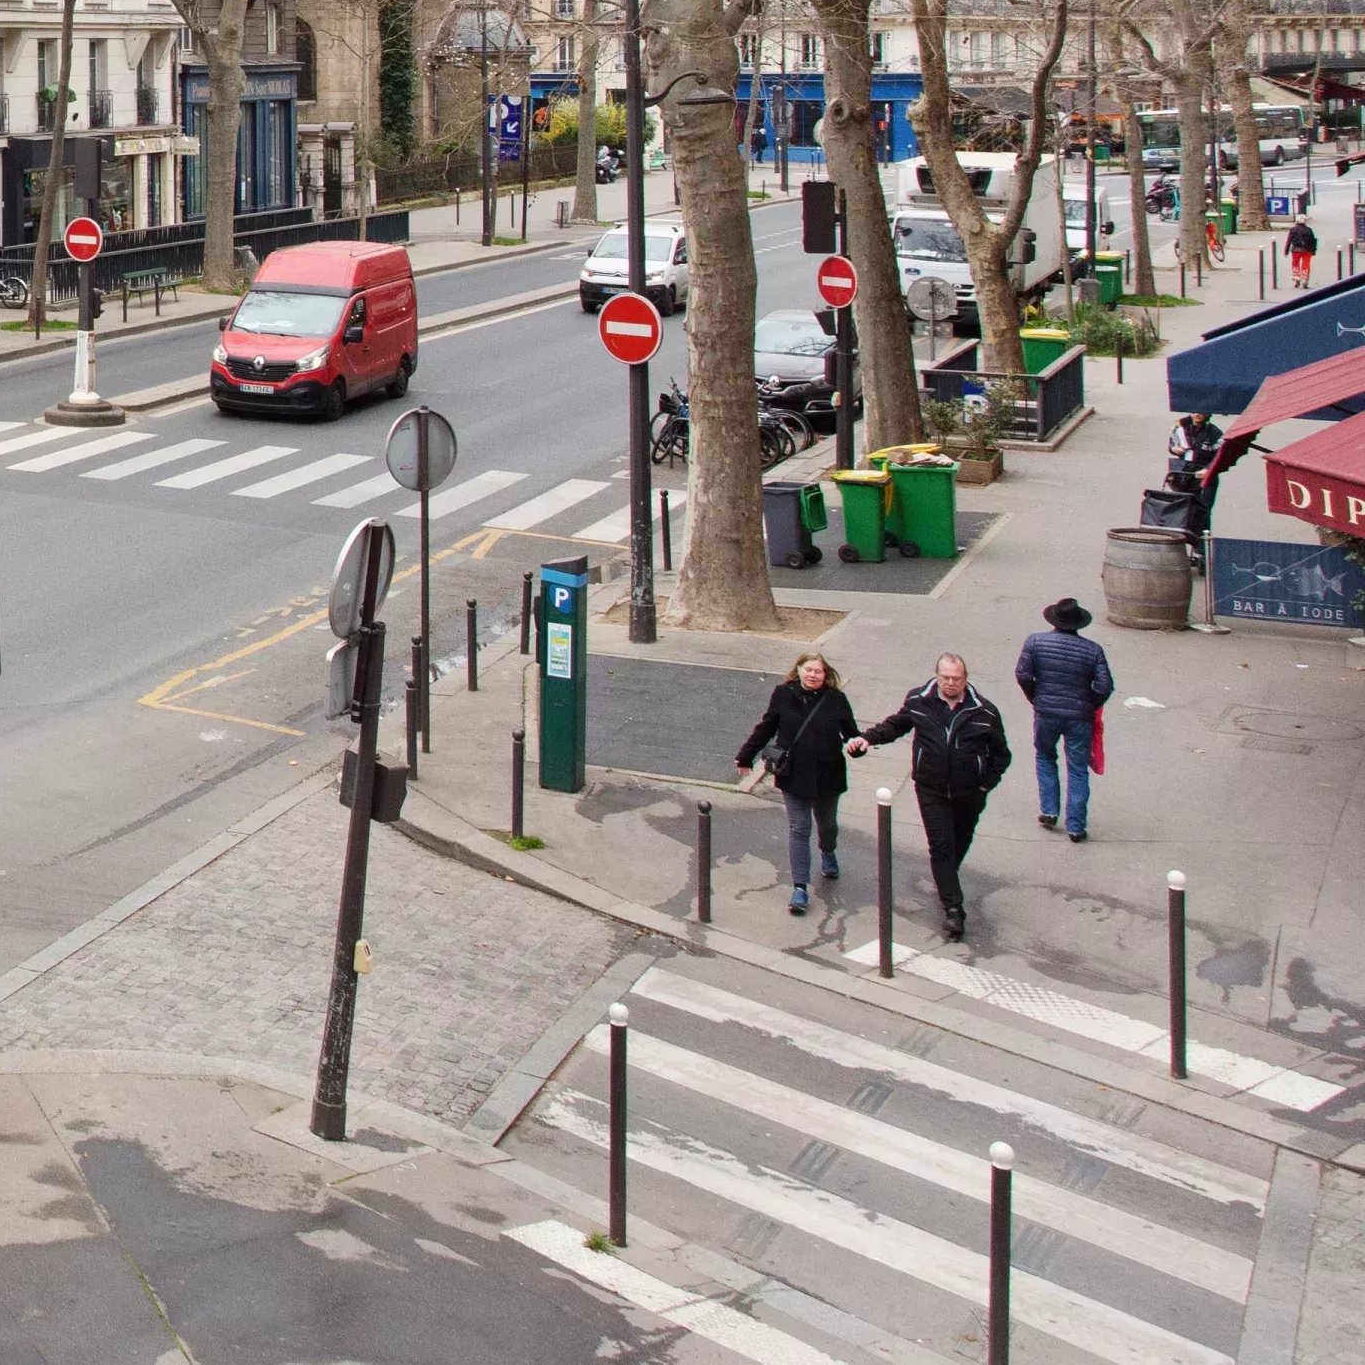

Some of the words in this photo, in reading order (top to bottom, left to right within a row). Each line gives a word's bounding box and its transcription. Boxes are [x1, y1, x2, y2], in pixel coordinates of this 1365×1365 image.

[1270, 200, 1283, 213] P
[554, 587, 569, 608] P
[1233, 600, 1265, 613] BAR
[1301, 606, 1344, 620] IODE
